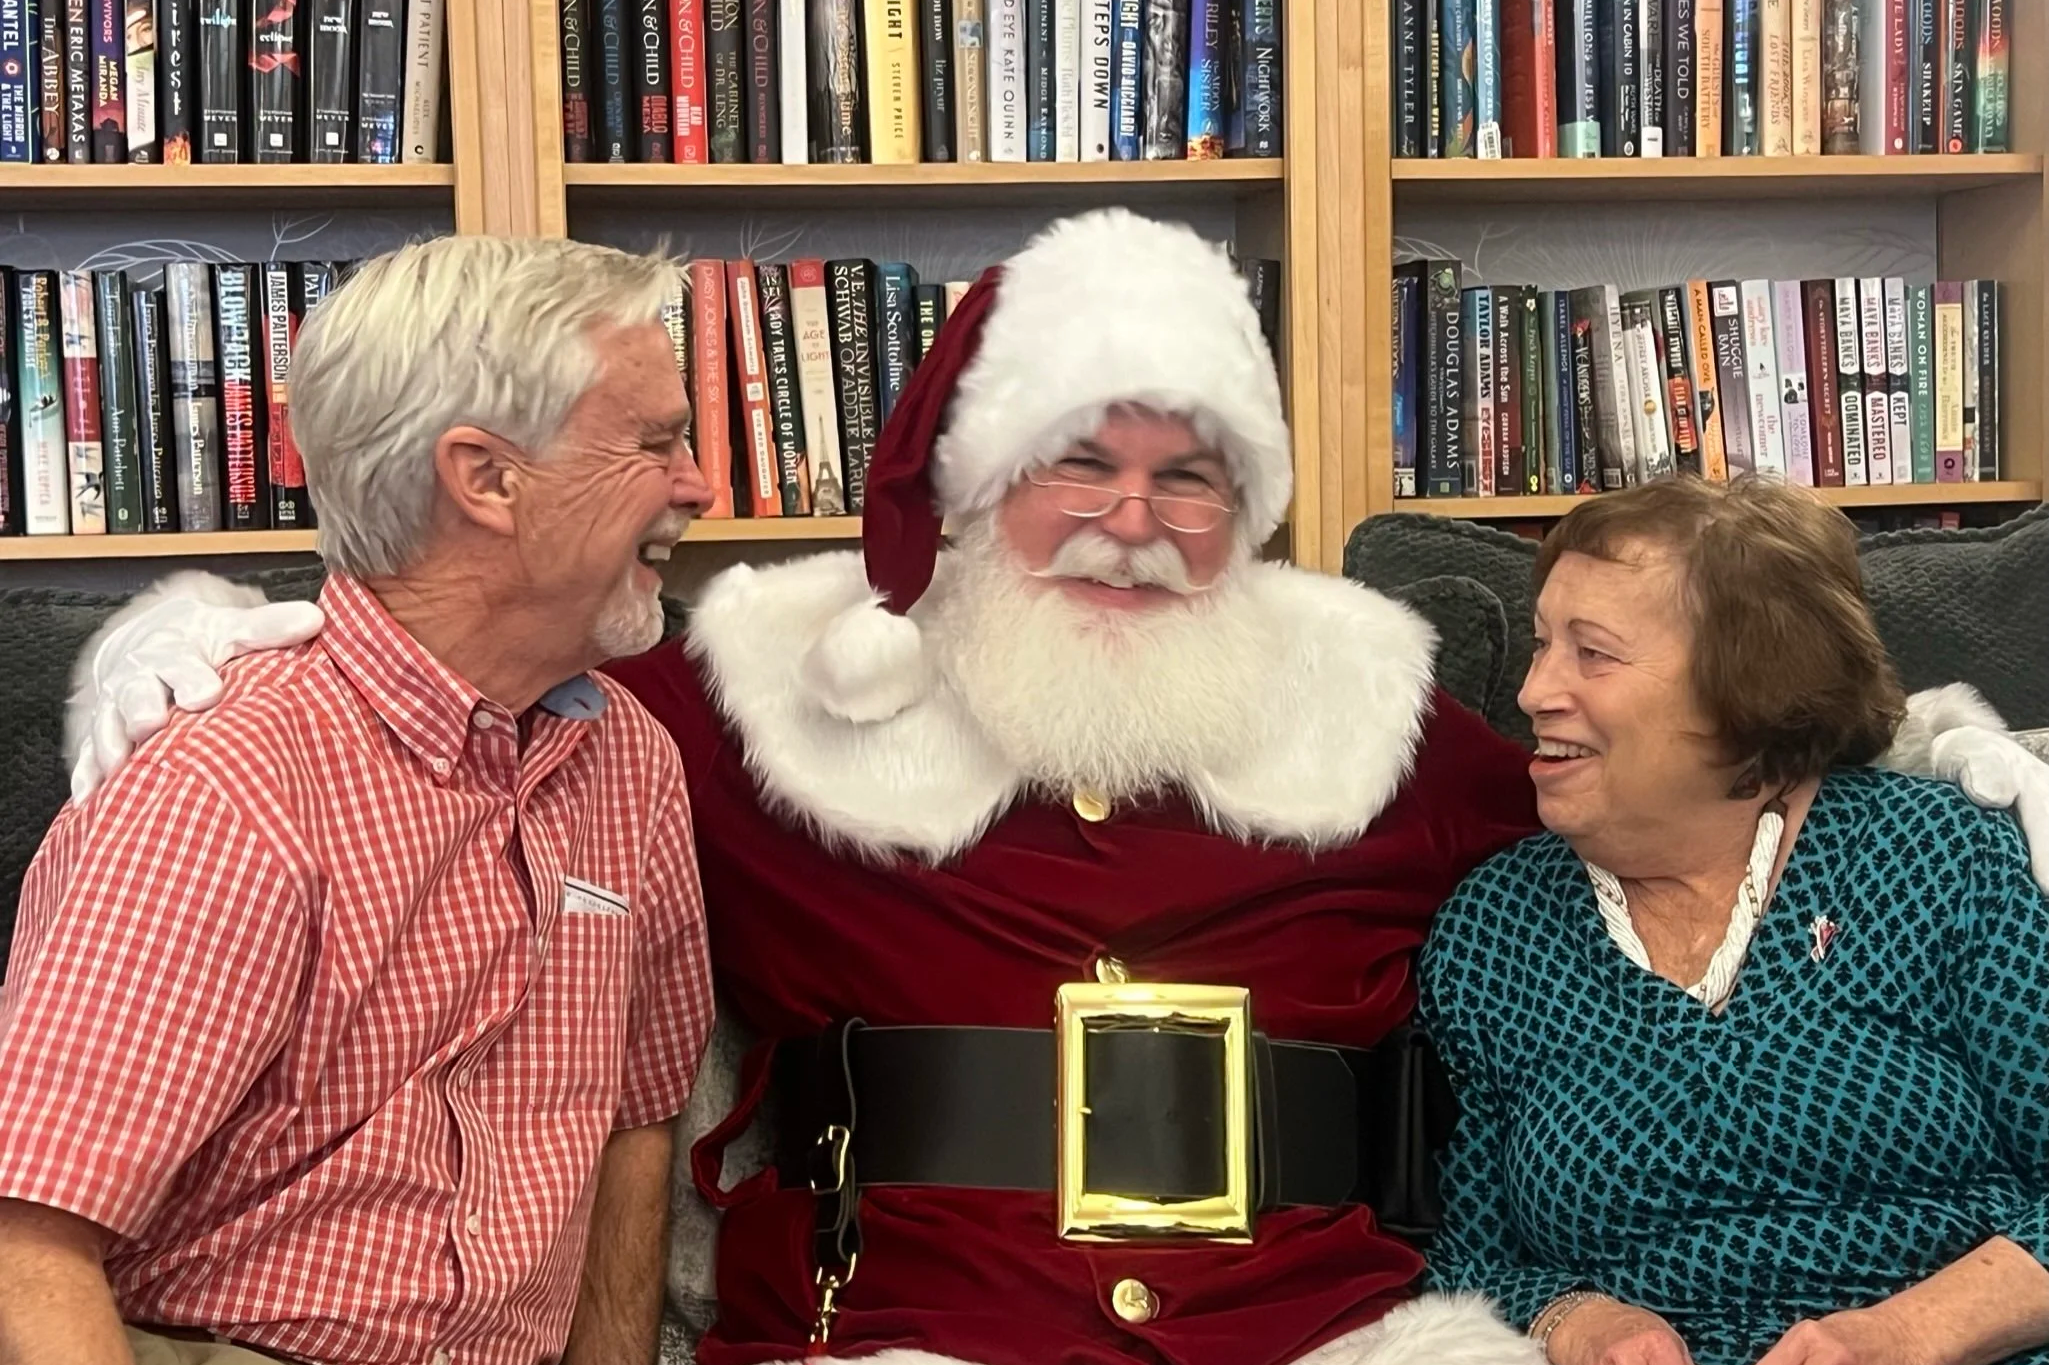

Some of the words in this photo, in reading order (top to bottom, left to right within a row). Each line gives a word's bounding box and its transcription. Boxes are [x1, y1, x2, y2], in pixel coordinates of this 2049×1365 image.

[70, 27, 84, 62] ERIC
[417, 12, 431, 68] PATIENT
[934, 16, 943, 42] now
[1004, 14, 1015, 40] EYE
[1205, 3, 1219, 50] RILEY
[1404, 2, 1414, 55] ANNE
[1624, 24, 1633, 58] CABIN
[1678, 24, 1689, 51] WE
[1894, 19, 1904, 54] LADY
[1004, 49, 1015, 82] KATE
[1121, 41, 1136, 76] DAVID
[1624, 62, 1633, 75] 10
[1700, 30, 1710, 71] SOUTH
[1769, 35, 1780, 66] LOST
[99, 55, 108, 107] MIRANDA
[110, 61, 119, 101] MEGAN
[892, 63, 901, 102] STEVEN
[1094, 57, 1109, 110] DOWN
[1200, 59, 1212, 112] SISTER
[1404, 65, 1415, 124] TYLER
[1584, 83, 1595, 109] JESS
[1678, 57, 1690, 99] TOLD
[1922, 62, 1931, 126] SHAKEUP
[1953, 62, 1963, 93] SKIN
[71, 69, 85, 142] METAXAS
[642, 96, 651, 133] MESA
[652, 96, 667, 133] DIABLO
[715, 94, 726, 129] LENG
[728, 72, 739, 131] CABINET
[1004, 90, 1015, 140] QUINN
[1120, 78, 1136, 136] RICCIARDI
[1769, 71, 1780, 125] FRIENDS
[2, 114, 12, 142] LIGHT
[894, 108, 904, 140] PRICE
[1953, 98, 1962, 137] GAME
[703, 266, 714, 300] DAISY
[851, 264, 864, 277] V.
[851, 281, 865, 297] E.
[270, 275, 287, 312] JAMES
[834, 265, 853, 343] SCHWAB
[885, 275, 900, 308] Lisa
[704, 304, 718, 346] JONES
[768, 306, 784, 336] LADY
[853, 300, 869, 338] THE
[920, 300, 933, 323] THE
[1478, 294, 1490, 348] TAYLOR
[1696, 299, 1705, 322] MAN
[1839, 298, 1853, 326] MAYA
[1864, 298, 1878, 327] MAYA
[1888, 298, 1902, 327] MAYA
[1917, 288, 1926, 339] WOMAN
[272, 315, 289, 381] PATTERSON
[887, 311, 903, 392] Scottoline
[1499, 331, 1509, 363] Across
[1610, 306, 1625, 363] HYENA
[1698, 324, 1708, 359] CALLED
[1718, 333, 1731, 367] BAIN
[1728, 318, 1743, 379] SHUGGIE
[1840, 331, 1855, 368] BANKS
[1865, 331, 1881, 368] BANKS
[1888, 331, 1904, 368] BANKS
[707, 360, 720, 383] THE
[839, 348, 855, 376] OF
[1446, 311, 1460, 399] DOUGLAS
[1918, 344, 1928, 364] ON
[855, 341, 875, 438] INVISIBLE
[1479, 353, 1491, 398] ADAMS
[1500, 366, 1509, 382] the
[1702, 363, 1711, 383] OVE
[1918, 370, 1928, 396] FIRE
[224, 381, 253, 426] JAMES
[708, 385, 720, 403] SIX
[776, 378, 792, 418] CIRCLE
[841, 378, 860, 438] ADDIE
[1500, 385, 1511, 403] Sun
[1893, 396, 1907, 425] KEPT
[781, 422, 794, 437] OF
[1446, 405, 1460, 469] ADAMS
[1766, 415, 1778, 434] the
[1845, 395, 1861, 465] DOMINATED
[1870, 397, 1886, 460] MASTERED
[227, 430, 256, 503] PATTERSON
[783, 441, 798, 485] WOMEN
[847, 444, 865, 508] LARUE
